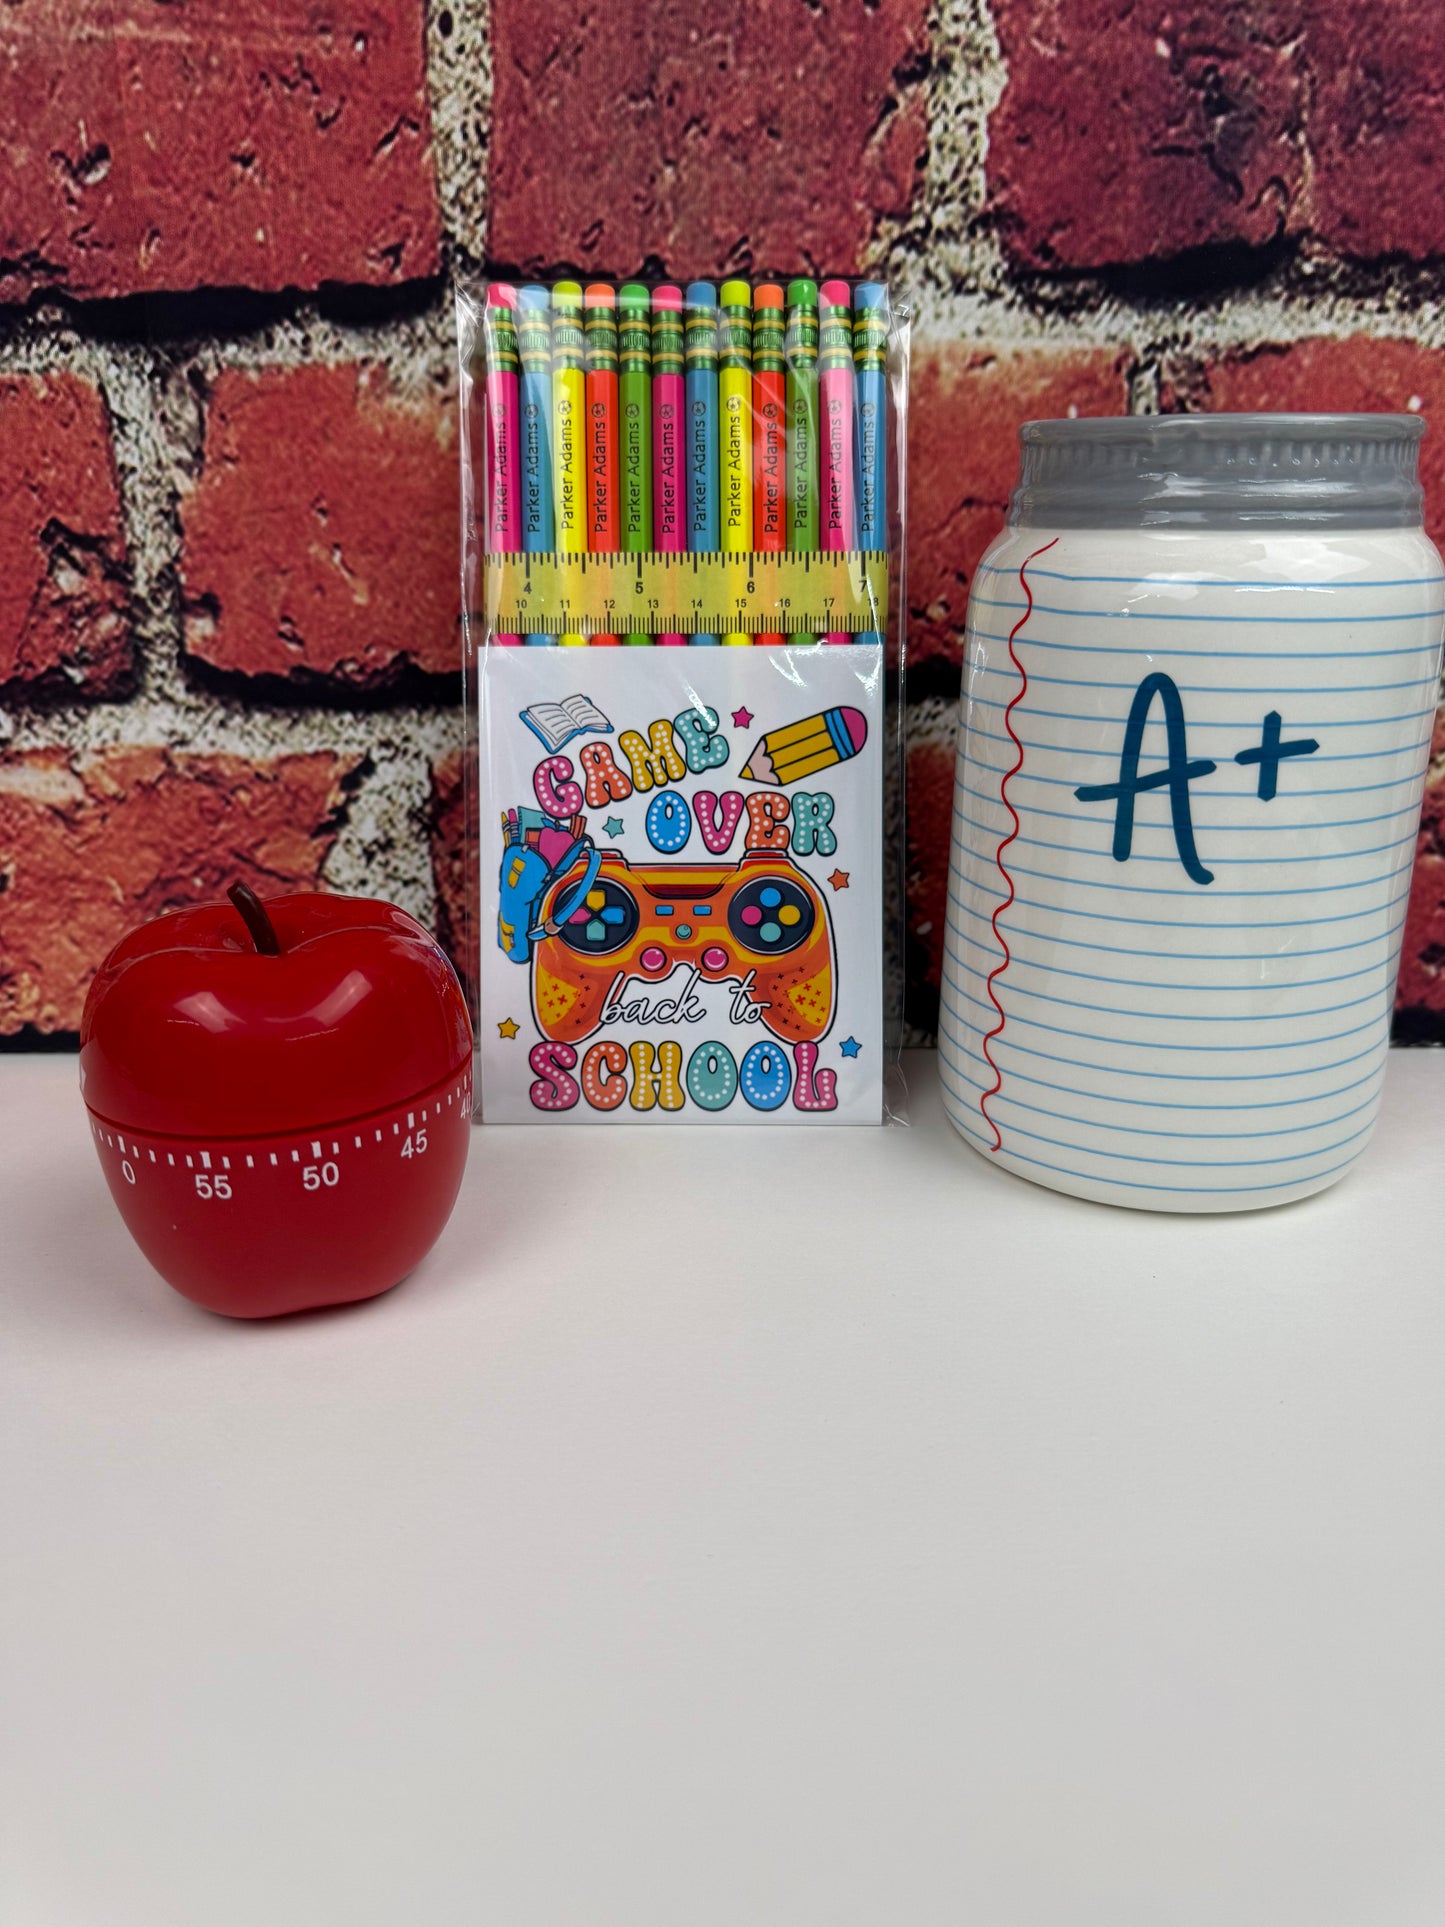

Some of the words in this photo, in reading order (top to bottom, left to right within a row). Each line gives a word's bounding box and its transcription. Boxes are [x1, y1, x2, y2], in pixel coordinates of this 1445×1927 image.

[493, 422, 506, 476] Adams
[526, 423, 538, 476] Adams
[560, 419, 572, 473] Adams
[593, 422, 606, 476] Adams
[626, 422, 640, 476] Adams
[660, 423, 674, 477] Adams
[693, 420, 705, 475] Adams
[727, 416, 740, 470] Adams
[763, 423, 778, 476] Adams
[794, 418, 807, 472] Adams
[828, 418, 842, 472] Adams
[861, 422, 874, 475] Adams
[494, 481, 508, 532] Parker
[528, 481, 539, 532] Parker
[561, 478, 573, 529] Parker
[594, 481, 607, 532] Parker
[628, 481, 640, 532] Parker
[661, 482, 675, 534] Parker
[693, 480, 706, 531] Parker
[728, 475, 741, 526] Parker
[764, 482, 778, 533] Parker
[794, 478, 808, 528] Parker
[829, 477, 842, 529] Parker
[861, 481, 874, 532] Parker
[516, 600, 527, 608] 10
[560, 600, 570, 608] 11
[604, 600, 615, 608] 12
[648, 600, 659, 608] 13
[691, 600, 703, 608] 14
[736, 599, 746, 607] 15
[779, 599, 790, 607] 16
[823, 599, 835, 607] 17
[524, 582, 532, 594] 4
[635, 582, 643, 594] 5
[746, 581, 755, 593] 6
[858, 580, 868, 592] 7
[532, 706, 730, 819] GAME
[1073, 672, 1320, 885] A+
[645, 790, 837, 856] OVER
[600, 969, 707, 1025] back
[728, 970, 771, 1024] to
[529, 1040, 838, 1111] SCHOOL
[122, 1160, 136, 1184] 0
[195, 1174, 233, 1199] 55
[302, 1162, 340, 1190] 50
[400, 1129, 428, 1160] 45
[460, 1091, 471, 1119] 40
